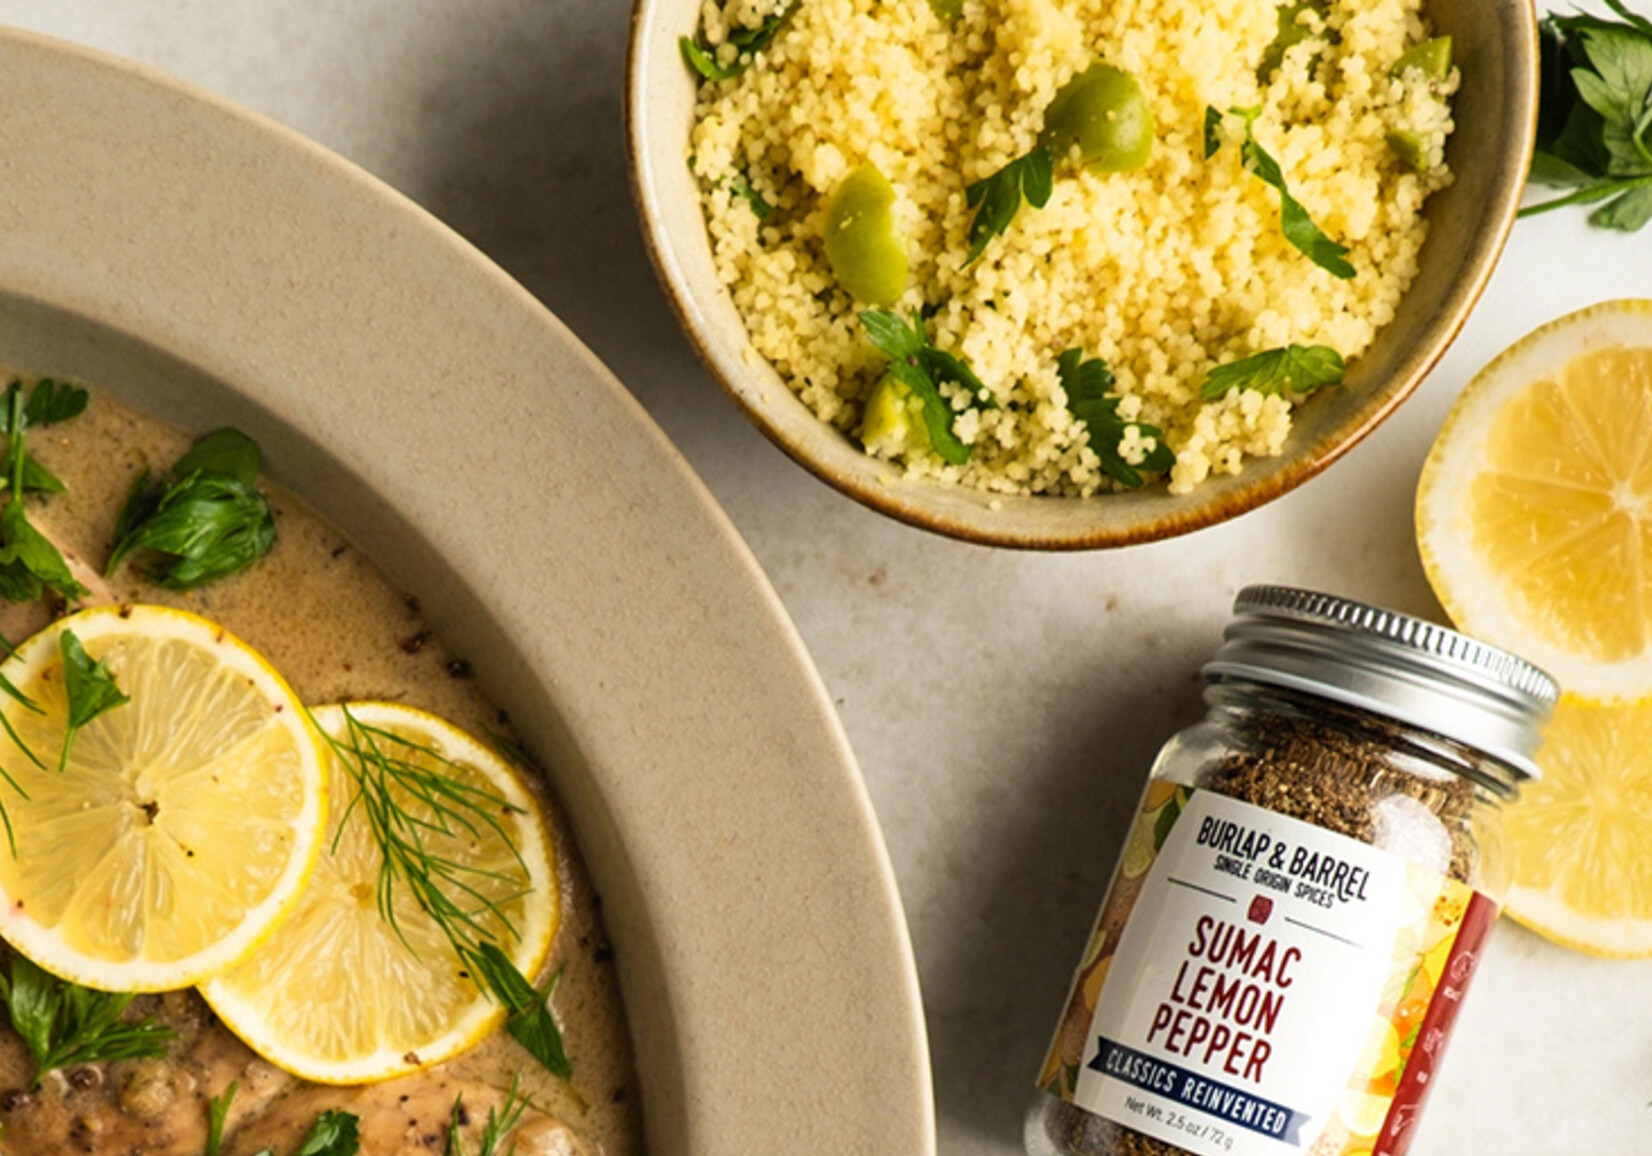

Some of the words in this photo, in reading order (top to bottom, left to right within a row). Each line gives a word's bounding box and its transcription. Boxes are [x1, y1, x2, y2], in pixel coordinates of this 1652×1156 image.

[1197, 816, 1270, 861] BURLAP
[1268, 842, 1287, 870] &
[1289, 846, 1370, 901] BARREL
[1214, 854, 1252, 879] SINGLE
[1253, 867, 1292, 893] ORIGIN
[1294, 882, 1335, 909] SPICES
[1187, 915, 1302, 988] SUMAC
[1170, 960, 1285, 1035] LEMON
[1146, 1003, 1272, 1083] PEPPER
[1106, 1049, 1178, 1092] CLASSICS
[1181, 1077, 1287, 1135] REINVENTED
[1125, 1096, 1144, 1115] Net
[1146, 1104, 1164, 1122] Wt.
[1165, 1111, 1186, 1131] 2.5
[1186, 1120, 1200, 1136] oz
[1209, 1127, 1225, 1146] 72
